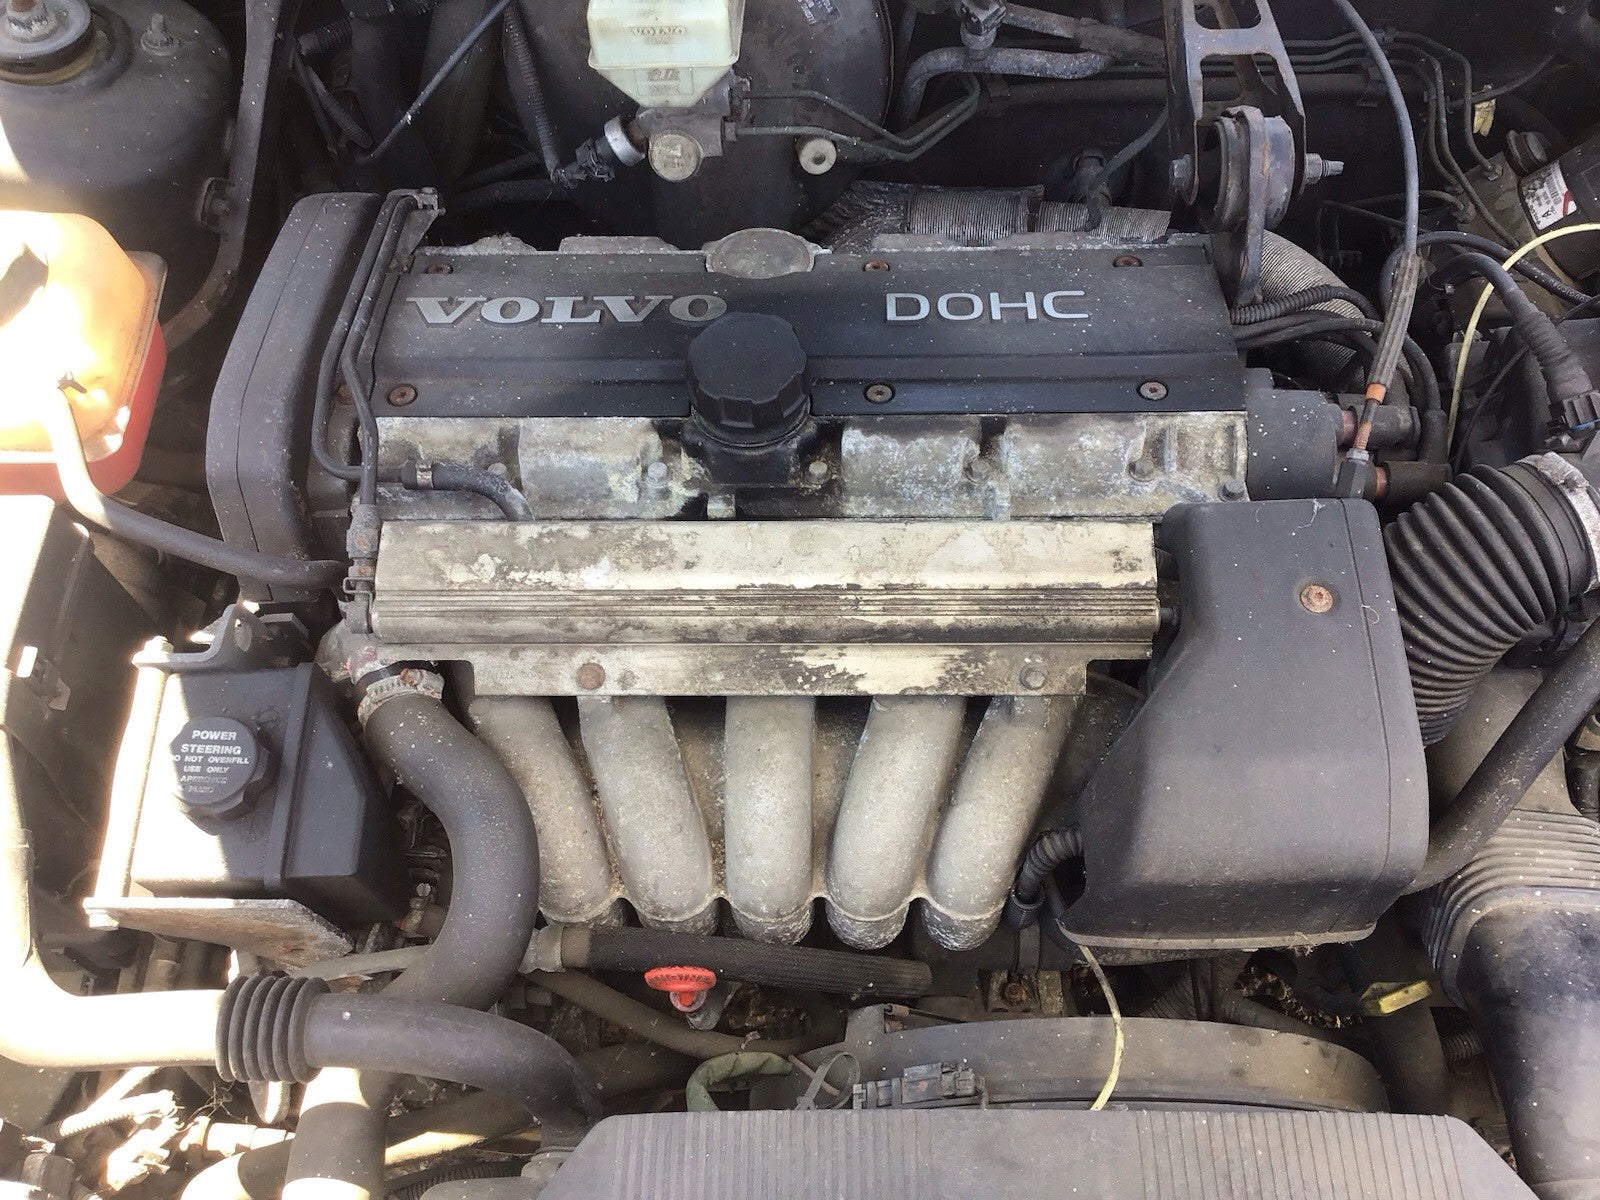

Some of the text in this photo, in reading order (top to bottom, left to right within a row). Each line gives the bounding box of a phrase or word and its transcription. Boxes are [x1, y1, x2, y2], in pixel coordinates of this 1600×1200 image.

[405, 290, 1089, 324] VOLVO DOHC
[191, 729, 237, 741] POWER
[180, 743, 242, 755] STEERING
[184, 755, 204, 763] NOT
[207, 755, 250, 765] OVERFILL
[183, 765, 230, 774] USE ONLY
